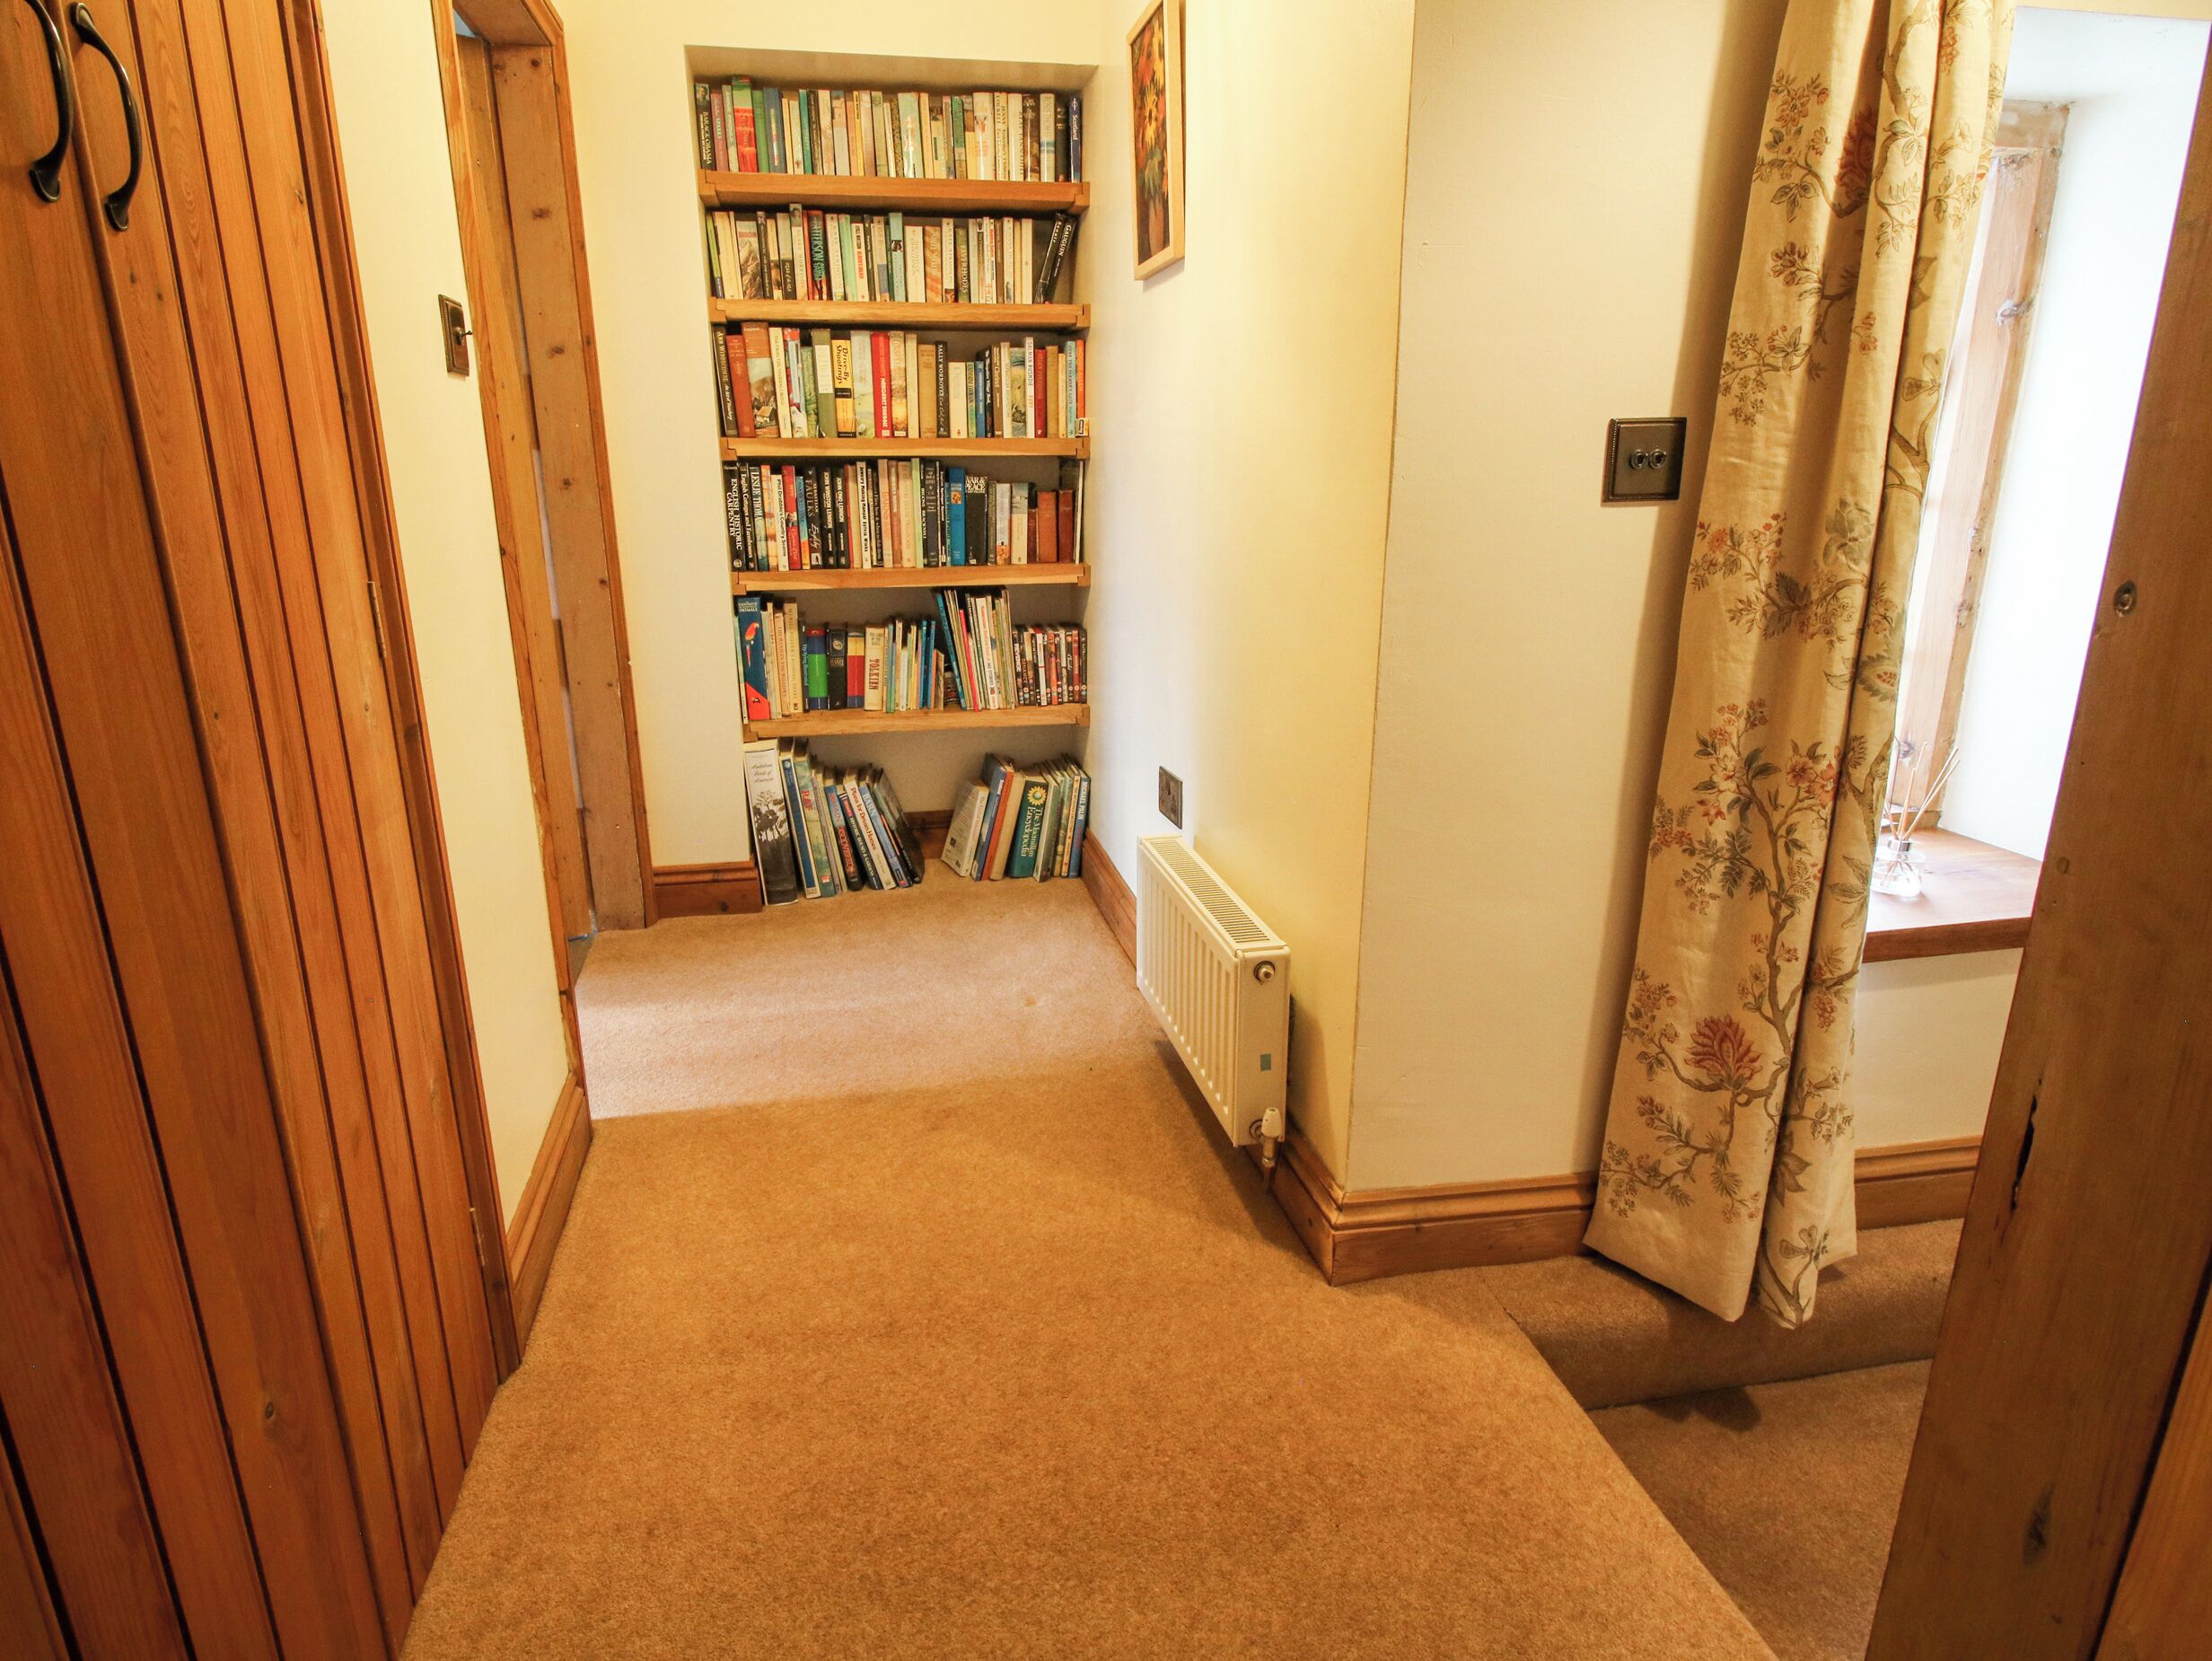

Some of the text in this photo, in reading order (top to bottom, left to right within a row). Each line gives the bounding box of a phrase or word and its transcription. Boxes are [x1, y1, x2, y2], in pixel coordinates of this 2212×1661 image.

[812, 221, 825, 261] PATTERSON
[1053, 221, 1061, 243] Renoir
[1058, 225, 1072, 257] GAUGUIN
[726, 492, 735, 537] CARPENTRY
[732, 479, 742, 550] ENGLISH HISTORIC
[750, 471, 762, 524] LESLIE THOMAS
[805, 479, 814, 517] FAULKS
[742, 494, 750, 516] Cottages
[746, 527, 754, 558] Farmhouses
[869, 658, 880, 690] TOLKIEN
[849, 787, 860, 804] Plans
[866, 831, 877, 851] Homes
[862, 794, 877, 817] BARN
[1077, 781, 1088, 821] MICHAEL PALIN
[1021, 806, 1036, 857] Encyclopedia
[1029, 807, 1043, 857] The Macmillan
